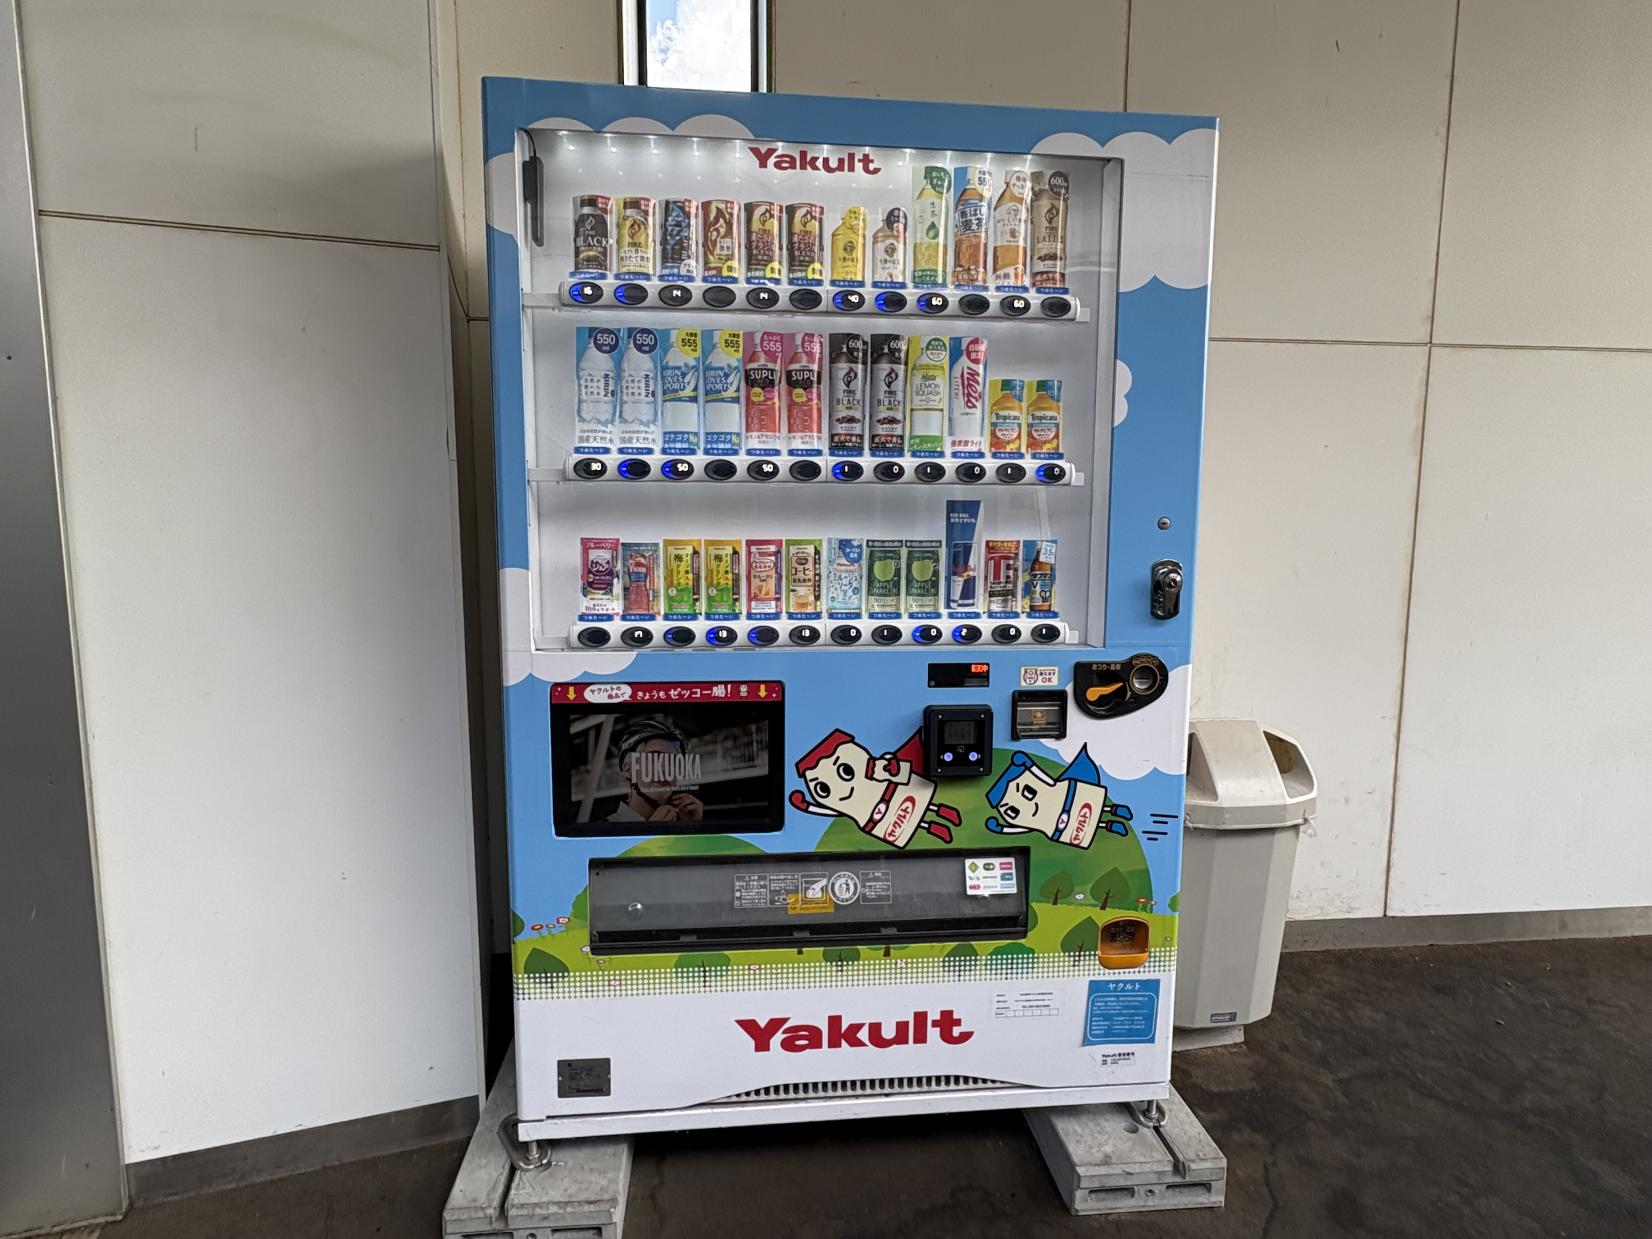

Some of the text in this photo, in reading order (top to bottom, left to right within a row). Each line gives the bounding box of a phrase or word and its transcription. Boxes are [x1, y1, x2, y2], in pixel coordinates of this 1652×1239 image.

[748, 146, 882, 175] Yakult
[1050, 177, 1064, 186] 600
[576, 237, 608, 247] BLACK
[596, 333, 616, 345] 550
[635, 333, 655, 345] 550
[681, 338, 698, 347] 555
[724, 339, 740, 348] 555
[763, 342, 782, 351] 555
[848, 340, 863, 349] 600
[916, 382, 940, 390] LEMON
[964, 366, 984, 410] Mets
[914, 389, 941, 398] SQUASH
[836, 398, 861, 406] BLACK
[877, 399, 901, 407] BLACK
[994, 412, 1021, 422] Tropicana
[1031, 413, 1058, 423] Tropicana
[577, 435, 614, 445] 国産天然水
[619, 435, 657, 445] 国産天然水
[951, 440, 982, 448] 強炭酸ライチ
[791, 566, 813, 576] コーヒー
[832, 573, 858, 581] ミルージュ
[876, 580, 894, 588] APPLE
[589, 685, 622, 696] ヤクルトの
[636, 690, 667, 700] きょうも
[631, 752, 702, 784] FUKUOKA
[886, 804, 909, 839] ヤクルト
[1072, 810, 1090, 841] ヤクルト
[1107, 982, 1141, 991] ヤクルト
[735, 1010, 974, 1053] Yakult
